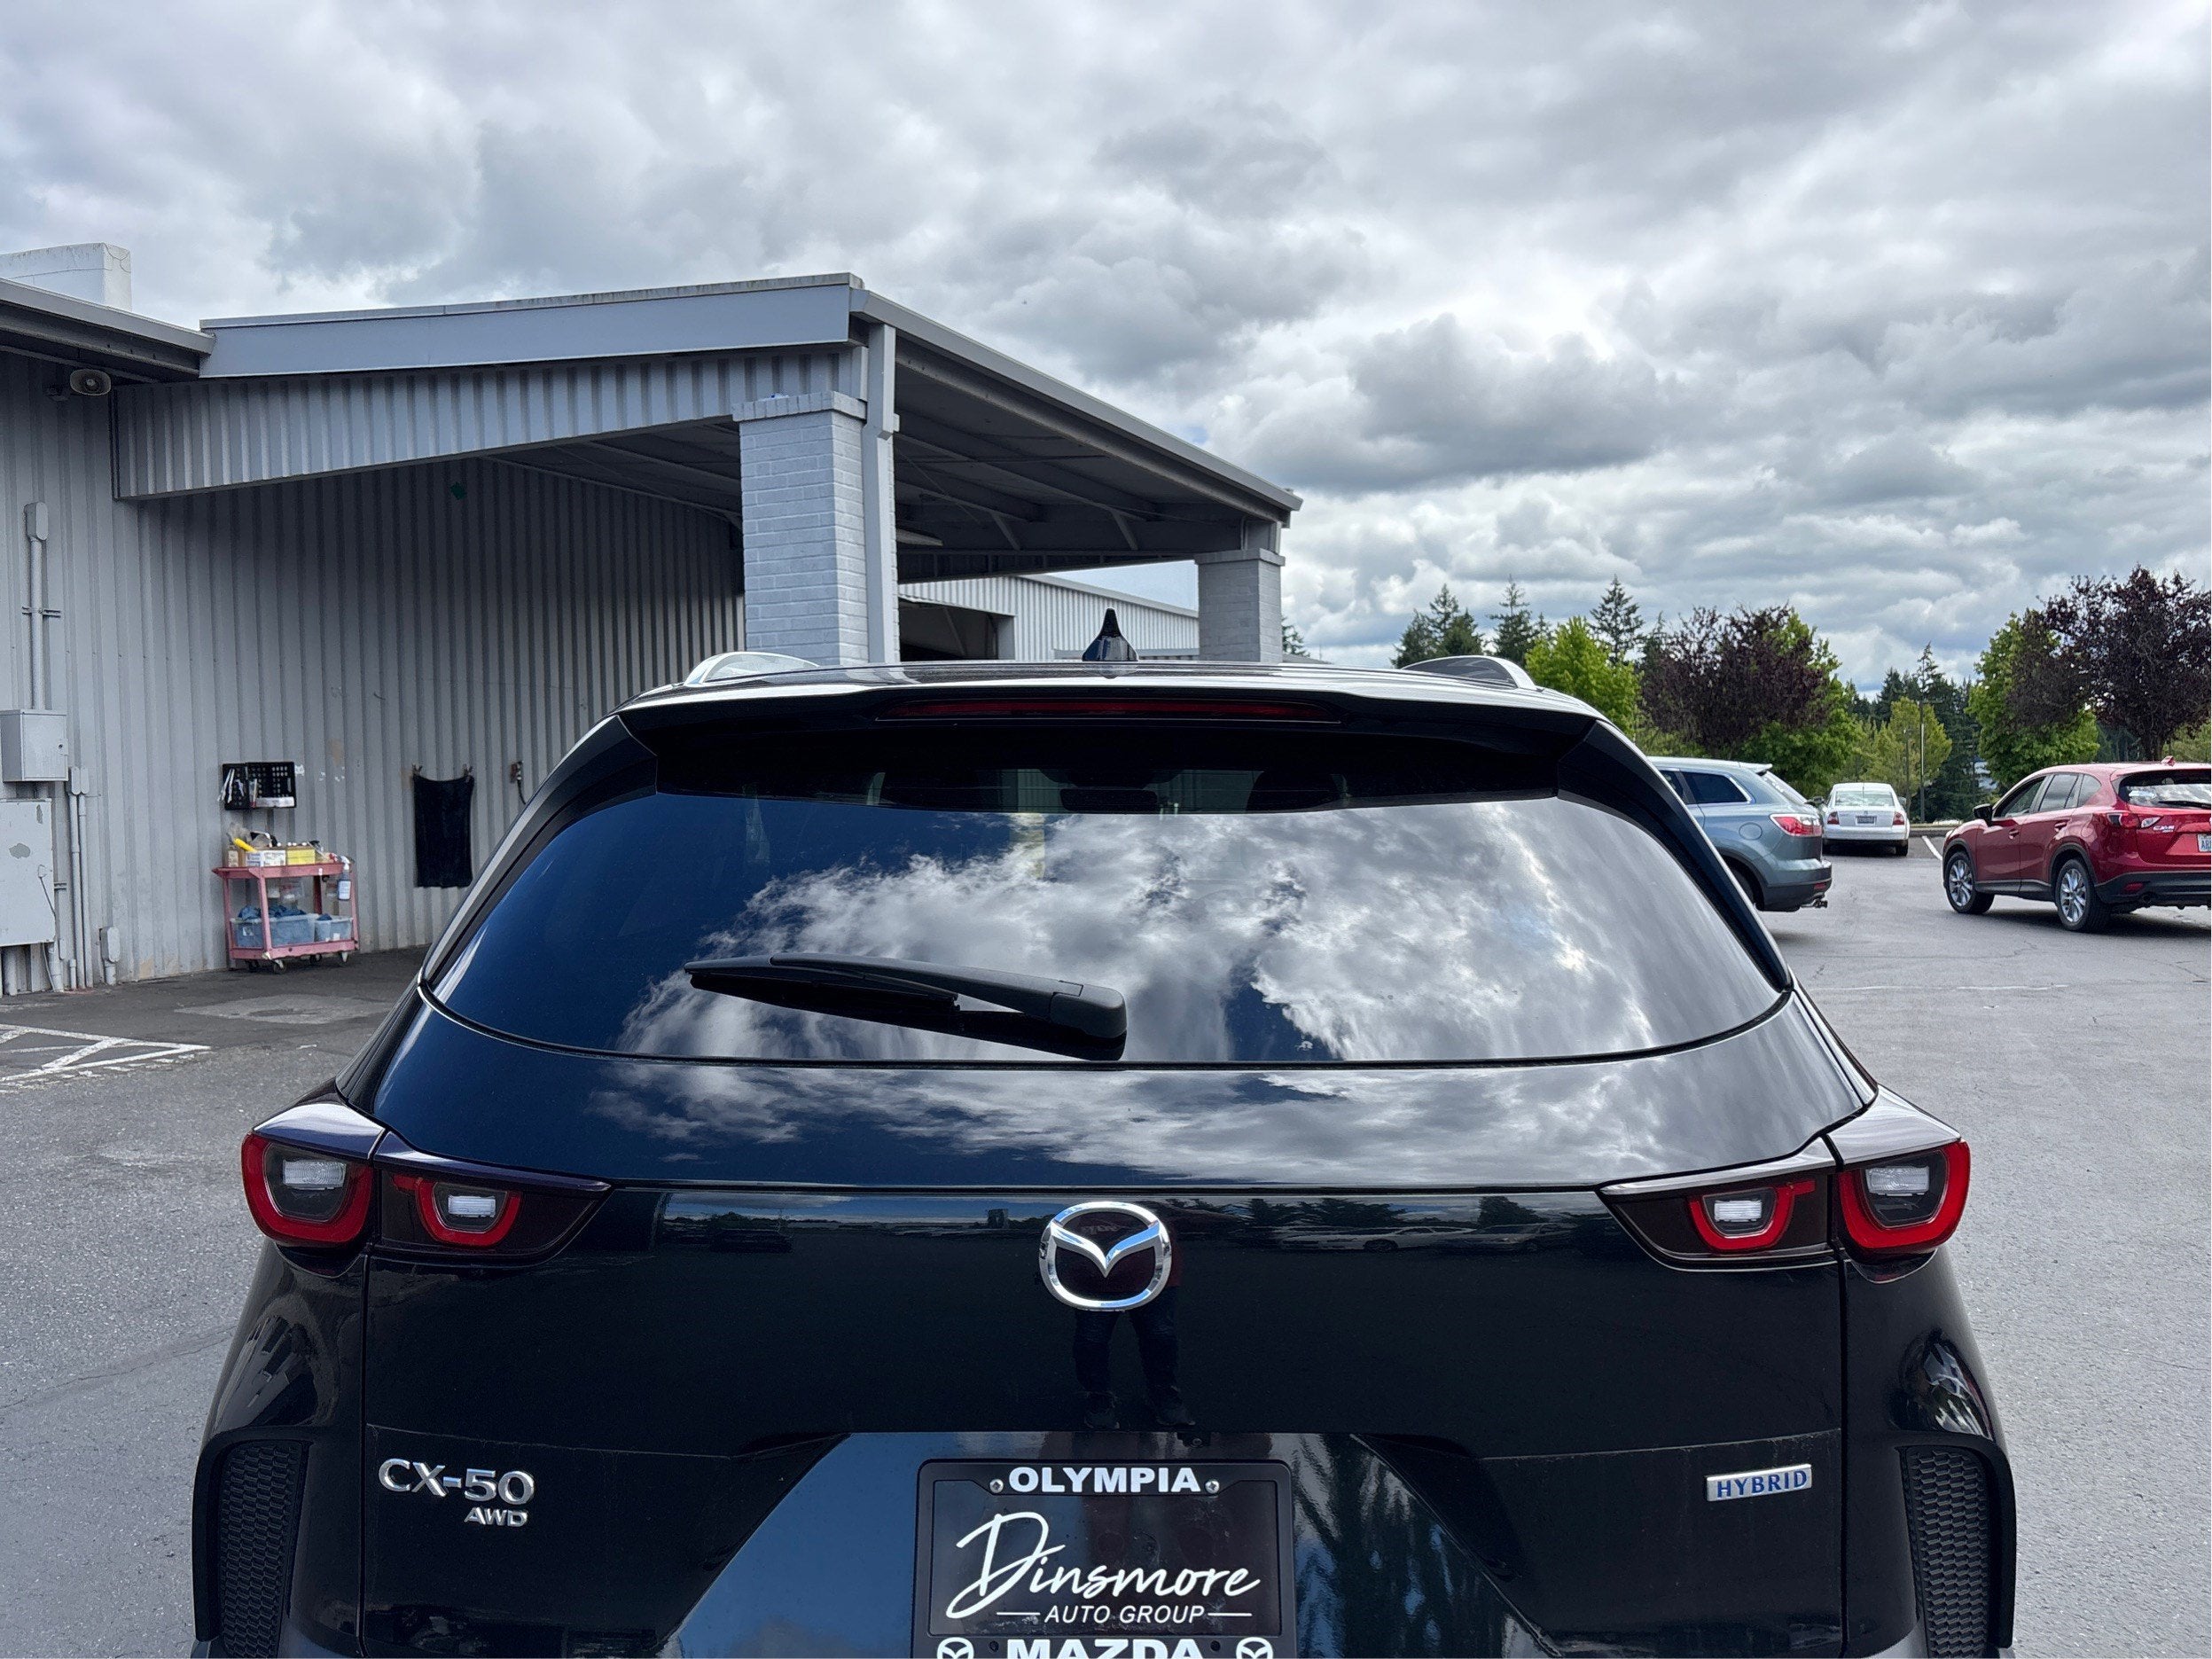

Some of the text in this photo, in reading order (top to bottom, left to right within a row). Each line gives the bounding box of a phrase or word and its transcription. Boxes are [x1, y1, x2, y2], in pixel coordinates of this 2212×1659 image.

[378, 1458, 535, 1506] CX-50
[1008, 1467, 1201, 1493] OLYMPIA
[1716, 1469, 1808, 1499] HYBRID
[463, 1506, 529, 1528] AWD
[945, 1511, 1261, 1619] Dinsmore
[1043, 1605, 1205, 1624] AUTO GROUP
[1006, 1639, 1203, 1658] MAZDA
